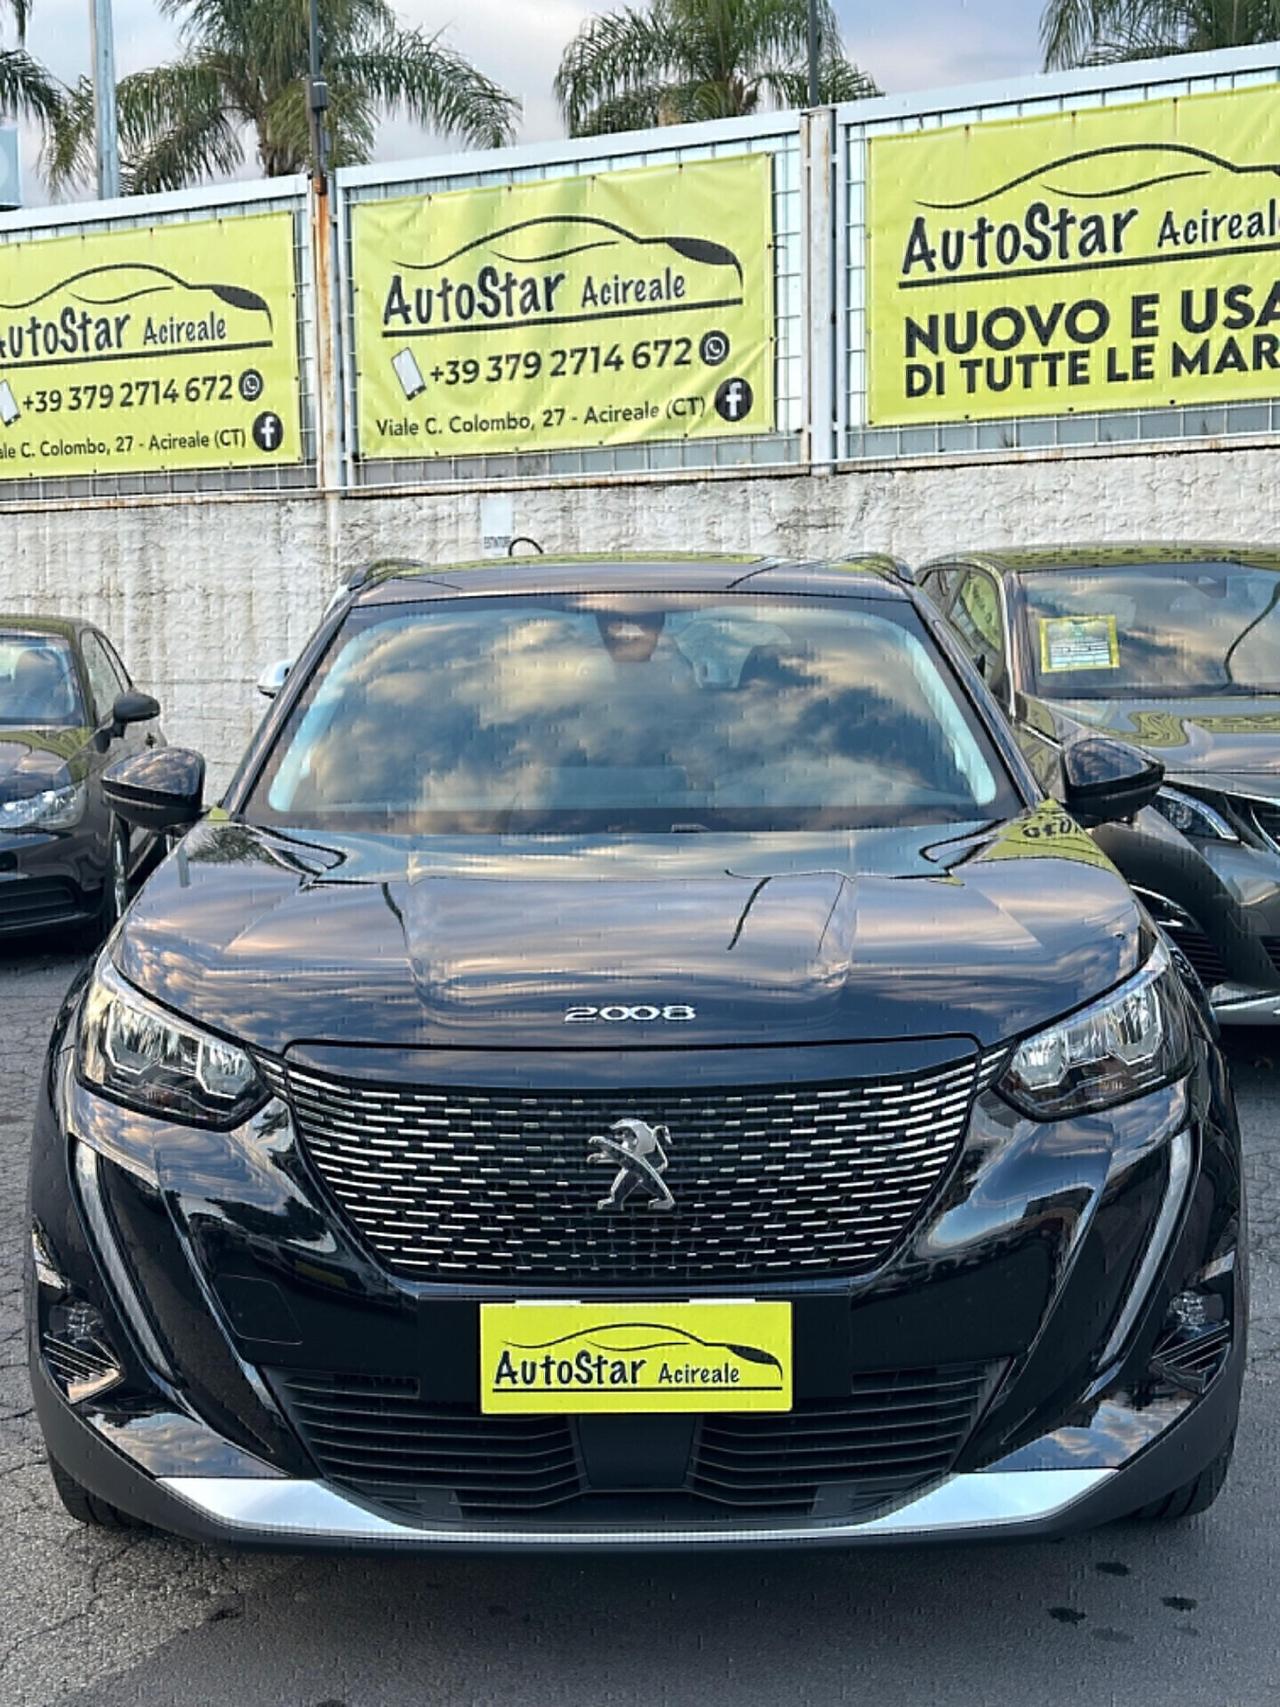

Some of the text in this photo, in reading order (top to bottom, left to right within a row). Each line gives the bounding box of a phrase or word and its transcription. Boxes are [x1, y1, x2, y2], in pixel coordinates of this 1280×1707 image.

[901, 198, 1280, 275] AutoStar Acireal
[383, 266, 686, 326] AutoStar Acireale
[143, 311, 226, 346] Acireale
[904, 299, 1110, 359] NUOVO
[1130, 293, 1160, 339] E
[430, 337, 692, 386] +39 379 2714 672
[905, 333, 1280, 399] DI TUTTE LE MAR
[22, 374, 233, 414] +39 379 2714 672
[375, 417, 419, 436] Viale
[425, 417, 443, 435] C.
[449, 412, 536, 434] Colombo,
[542, 408, 566, 428] 27
[583, 400, 659, 425] Acireale
[665, 397, 706, 420] (CT)
[20, 441, 36, 458] C.
[39, 437, 111, 457] Colombo,
[116, 435, 134, 453] 27
[148, 431, 210, 451] Acireale
[214, 428, 246, 449] (CT)
[563, 1005, 697, 1022] 2008
[494, 1349, 741, 1386] AutoStar Acireale
